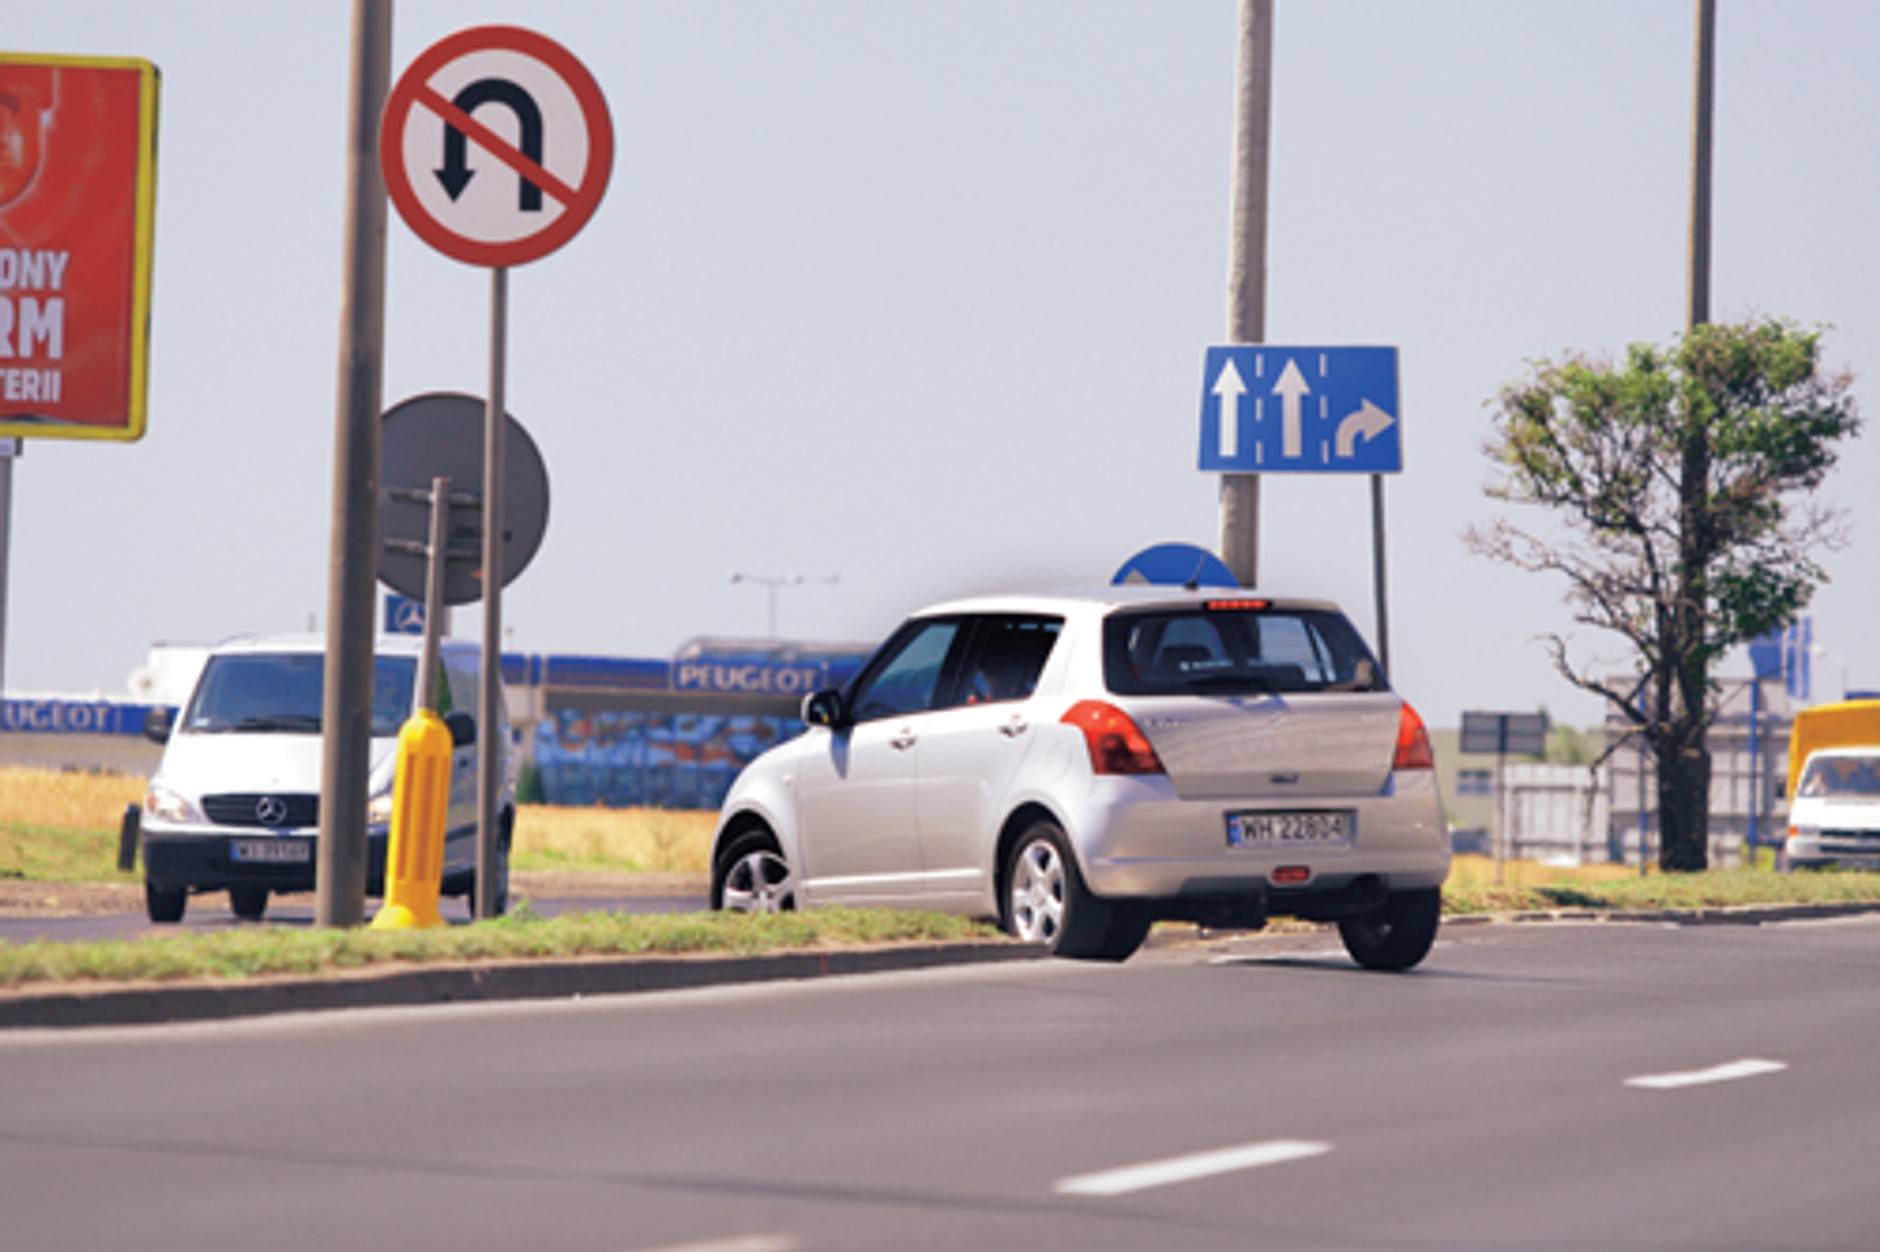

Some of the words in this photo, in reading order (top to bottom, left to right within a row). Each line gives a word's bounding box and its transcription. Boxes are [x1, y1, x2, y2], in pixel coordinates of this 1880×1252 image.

[0, 249, 70, 290] ONY
[0, 368, 61, 402] ERII
[680, 664, 818, 690] PEUGEOT
[1241, 815, 1273, 840] WH
